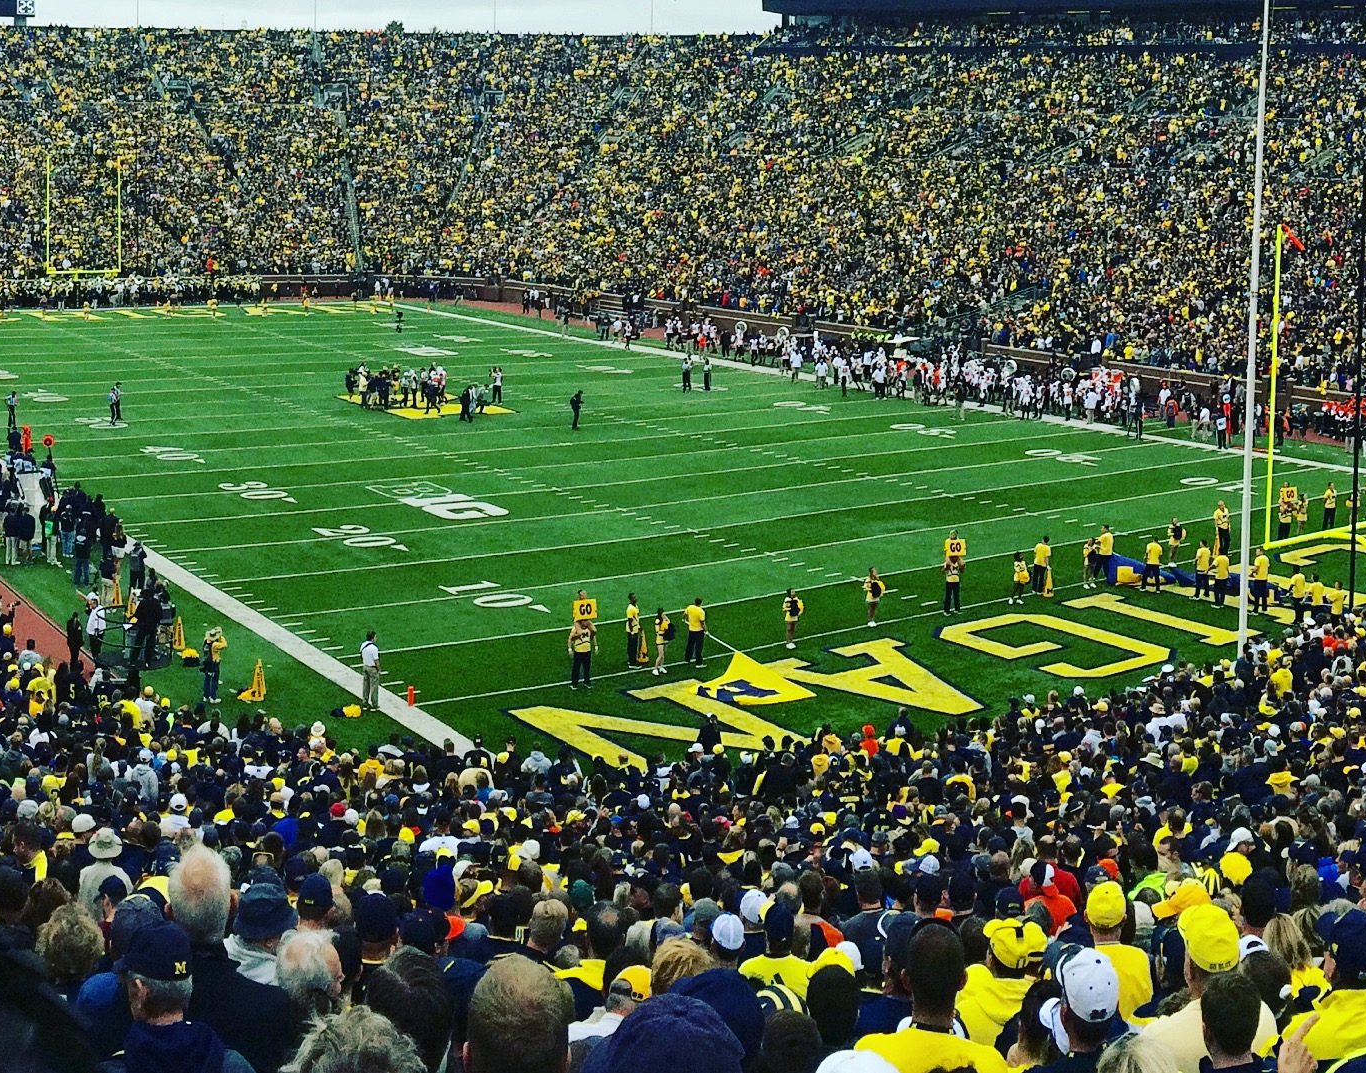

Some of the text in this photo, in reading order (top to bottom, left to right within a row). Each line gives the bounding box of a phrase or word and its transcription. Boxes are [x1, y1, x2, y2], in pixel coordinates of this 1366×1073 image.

[217, 480, 290, 501] 30
[311, 523, 397, 548] 20
[949, 540, 962, 554] GO
[438, 580, 535, 609] 10
[579, 603, 592, 616] GO
[175, 961, 187, 975] M
